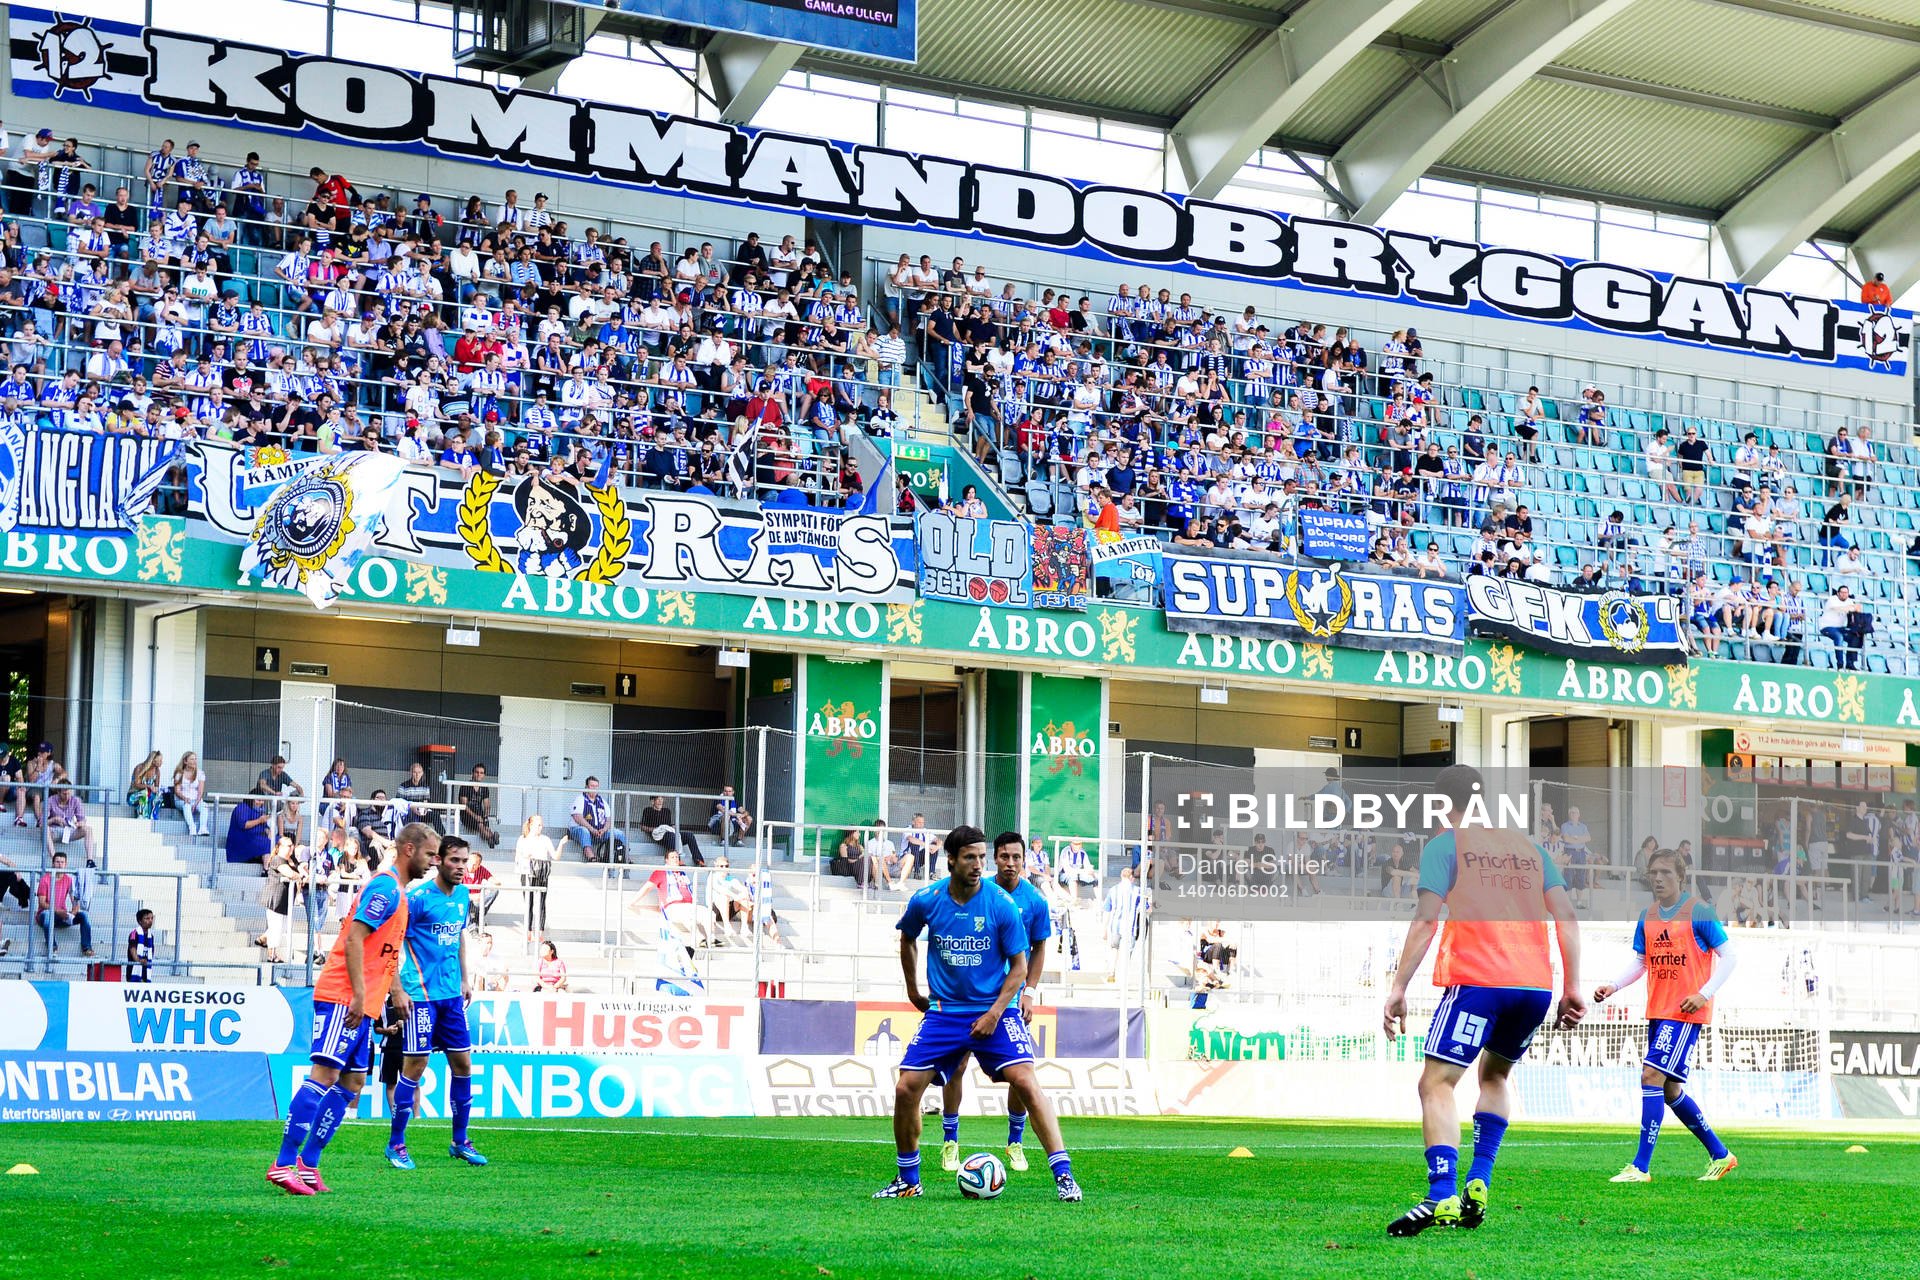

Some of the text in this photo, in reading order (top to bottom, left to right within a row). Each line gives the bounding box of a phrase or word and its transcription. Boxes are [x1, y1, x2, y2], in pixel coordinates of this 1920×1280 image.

[855, 8, 893, 23] ULLEVI
[146, 32, 1834, 356] KOMMANDOBRYGGAN
[766, 511, 818, 530] SYMPATI
[768, 530, 782, 543] DE
[919, 511, 1028, 579] OLD
[968, 606, 1096, 657] ÅBRO
[1557, 658, 1664, 705] ÅBRO
[1733, 674, 1834, 719] ÅBRO
[807, 713, 877, 739] ÅBRO
[1030, 732, 1096, 758] ÅBRO
[1463, 851, 1539, 872] Prioritet
[1479, 868, 1532, 890] Finans
[934, 934, 991, 951] Prioritet
[123, 990, 246, 1005] WANGESKOG
[417, 1008, 429, 1016] SE
[418, 1016, 431, 1025] RN
[1003, 1017, 1016, 1026] SE
[126, 1008, 242, 1046] WHC
[542, 1001, 744, 1049] HuseT
[1006, 1025, 1021, 1035] RN
[1662, 1025, 1675, 1035] SE
[1009, 1032, 1027, 1043] EKE
[1661, 1055, 1669, 1065] 6
[2, 1107, 196, 1121] återförsäljare av HYUNDAI
[316, 1108, 335, 1139] SKF
[1648, 1120, 1660, 1145] SKF
